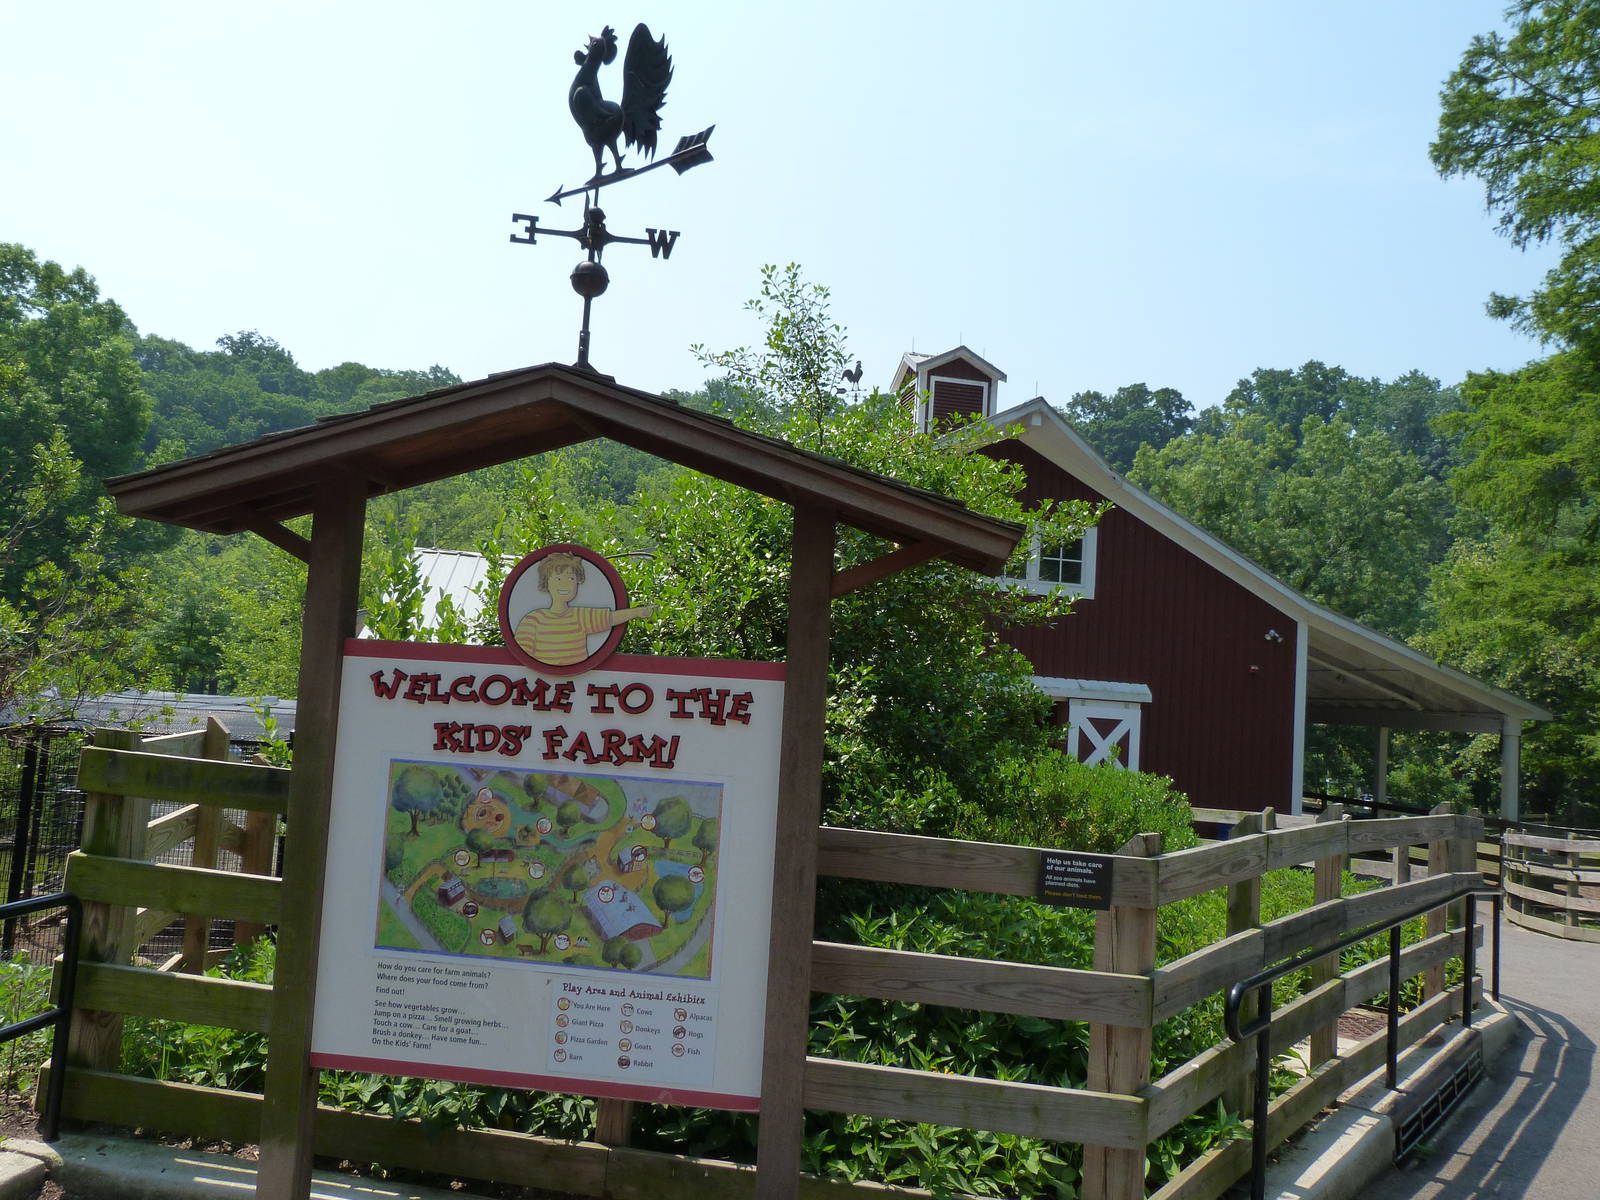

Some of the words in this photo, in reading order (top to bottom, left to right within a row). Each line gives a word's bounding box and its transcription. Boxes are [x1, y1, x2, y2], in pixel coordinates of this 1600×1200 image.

[646, 228, 680, 259] W
[369, 668, 575, 713] WELCOME
[587, 683, 654, 715] TO
[666, 688, 753, 726] THE
[433, 722, 532, 757] KIDS'
[542, 726, 681, 769] FARM!
[1047, 857, 1061, 865] Help
[377, 962, 392, 970] How
[404, 965, 416, 973] you
[433, 966, 443, 974] for
[462, 971, 491, 979] animals?
[376, 986, 389, 994] Find
[469, 981, 488, 989] from?
[563, 983, 582, 995] Play
[586, 986, 606, 995] Area
[610, 988, 625, 997] and
[629, 990, 663, 1000] Animal
[388, 1001, 402, 1009] how
[404, 1004, 439, 1012] vegetables
[422, 1023, 436, 1031] Care
[439, 1024, 448, 1032] for
[454, 1017, 481, 1027] growing
[373, 1028, 391, 1036] Brush
[432, 1034, 448, 1042] Have
[636, 1026, 661, 1034] Donkeys
[689, 1031, 703, 1039] Hogs
[383, 1038, 394, 1046] the
[413, 1041, 432, 1049] Farm!
